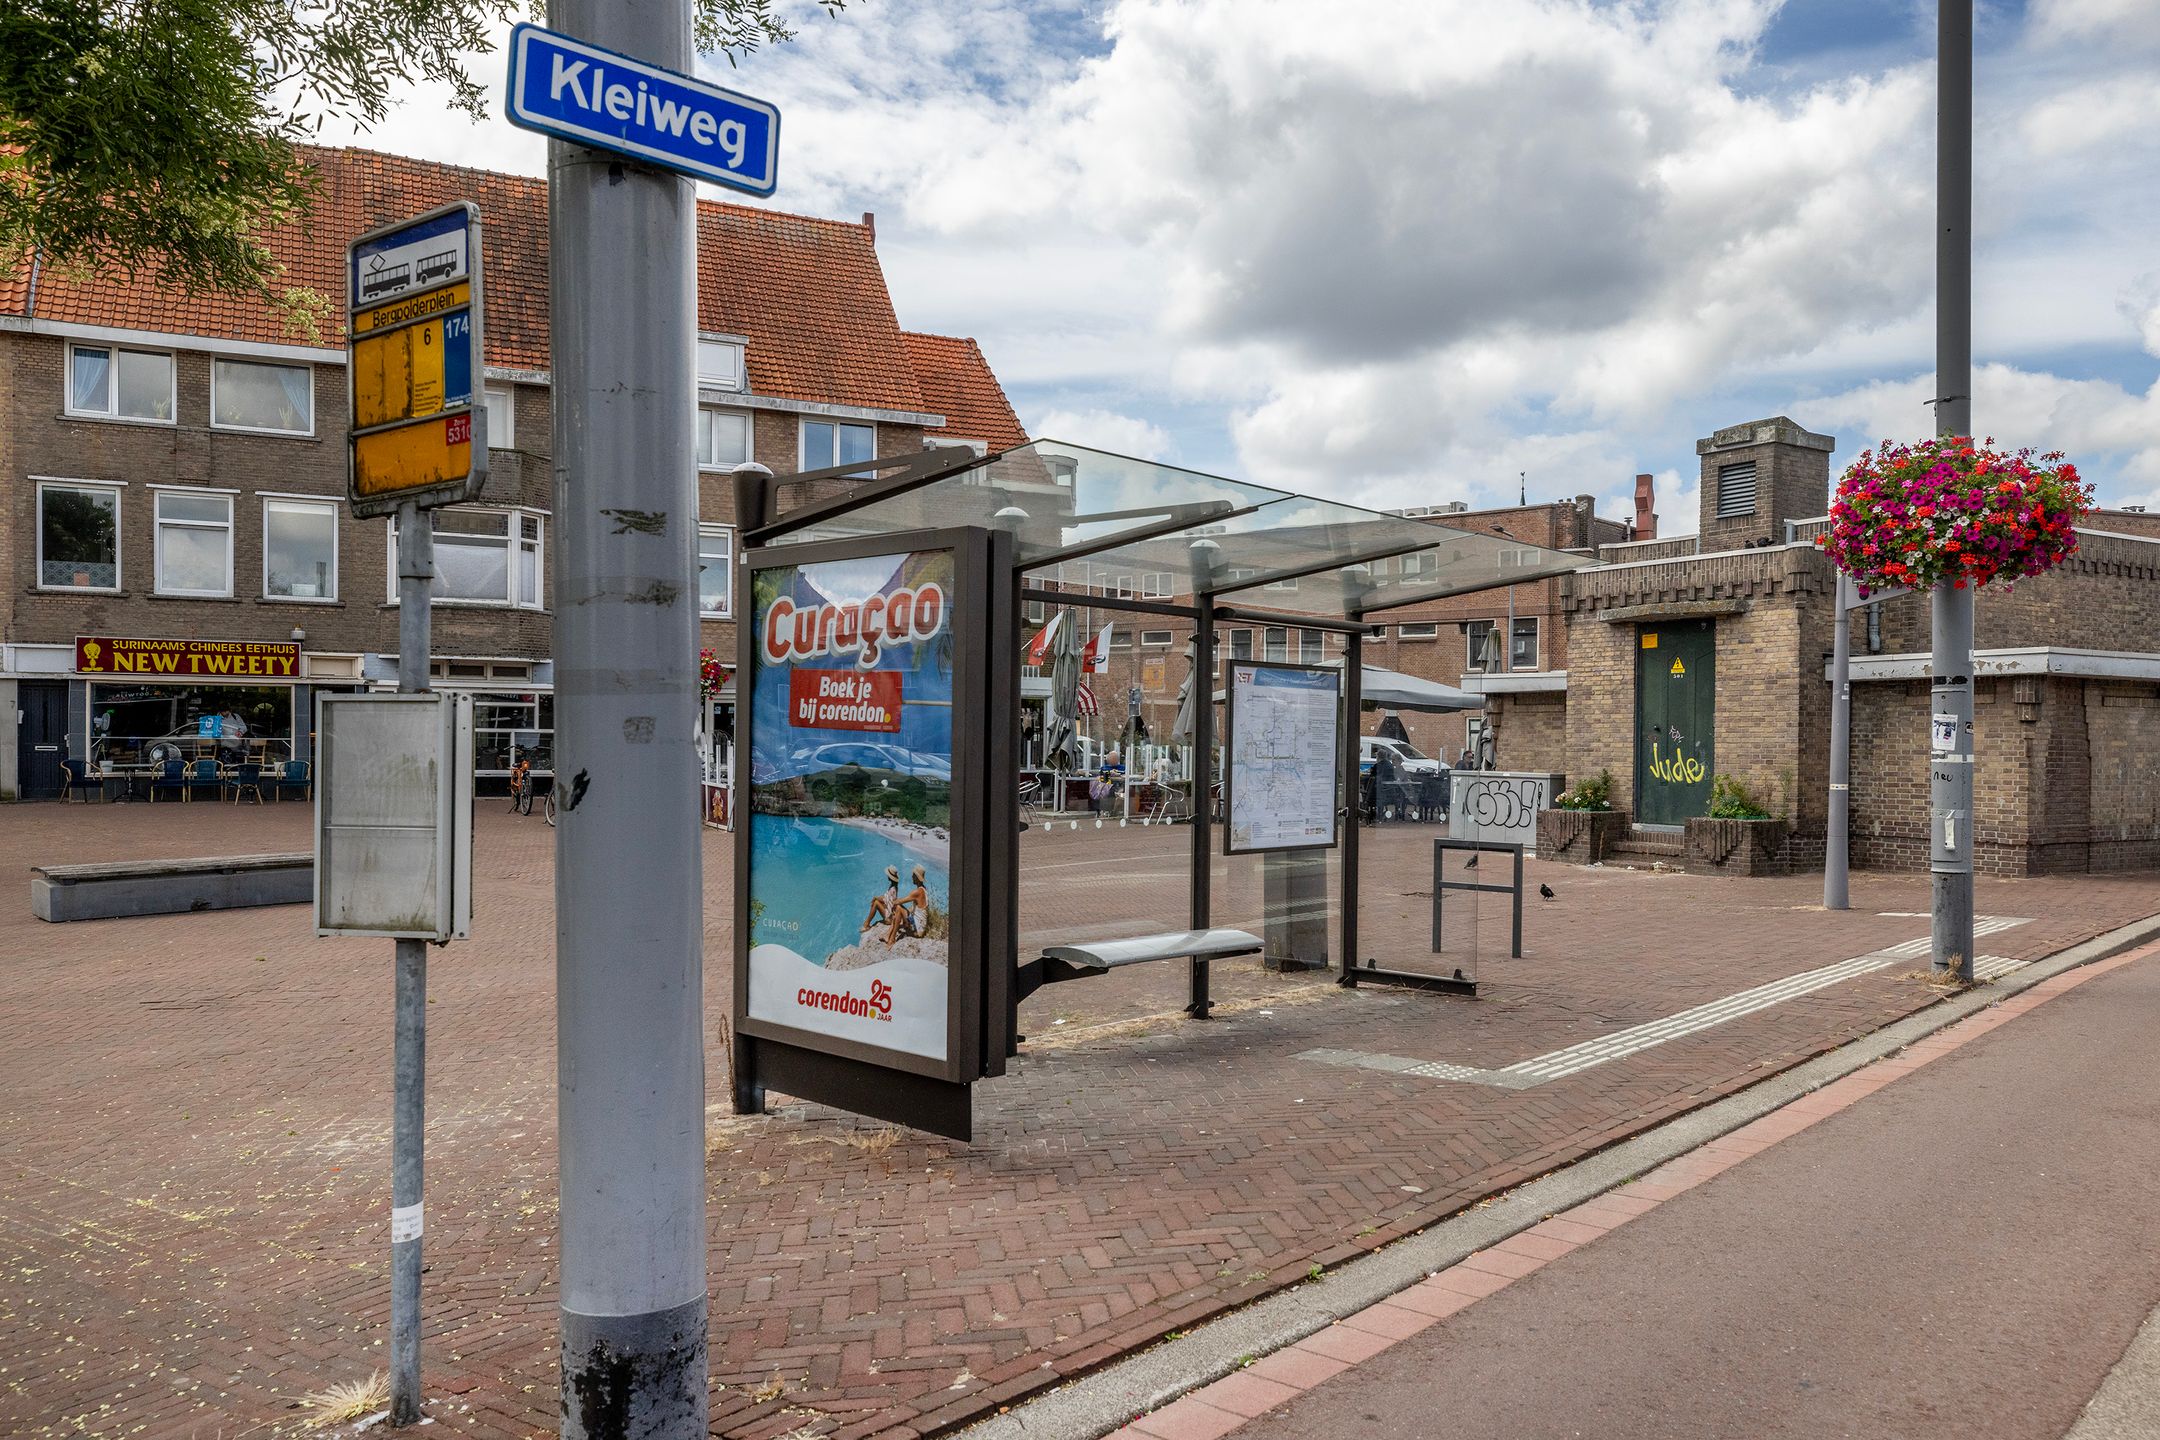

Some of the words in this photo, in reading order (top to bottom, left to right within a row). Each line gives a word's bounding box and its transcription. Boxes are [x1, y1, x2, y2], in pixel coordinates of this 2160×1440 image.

[550, 53, 746, 169] Kleiweg
[373, 289, 455, 328] Bergpolderplein
[423, 327, 432, 346] 6
[446, 315, 470, 339] 174
[765, 584, 942, 667] Curaçao
[112, 640, 186, 652] SURINAAMS
[189, 642, 242, 653] CHINEES
[245, 644, 295, 654] EETHUIS
[113, 652, 180, 673] NEW
[187, 653, 295, 676] TWEETY
[819, 676, 856, 699] Boek
[856, 677, 872, 701] je
[799, 699, 818, 724] bij
[1650, 742, 1705, 784] Jude
[869, 978, 893, 1014] 25
[876, 1012, 893, 1023] JAAR
